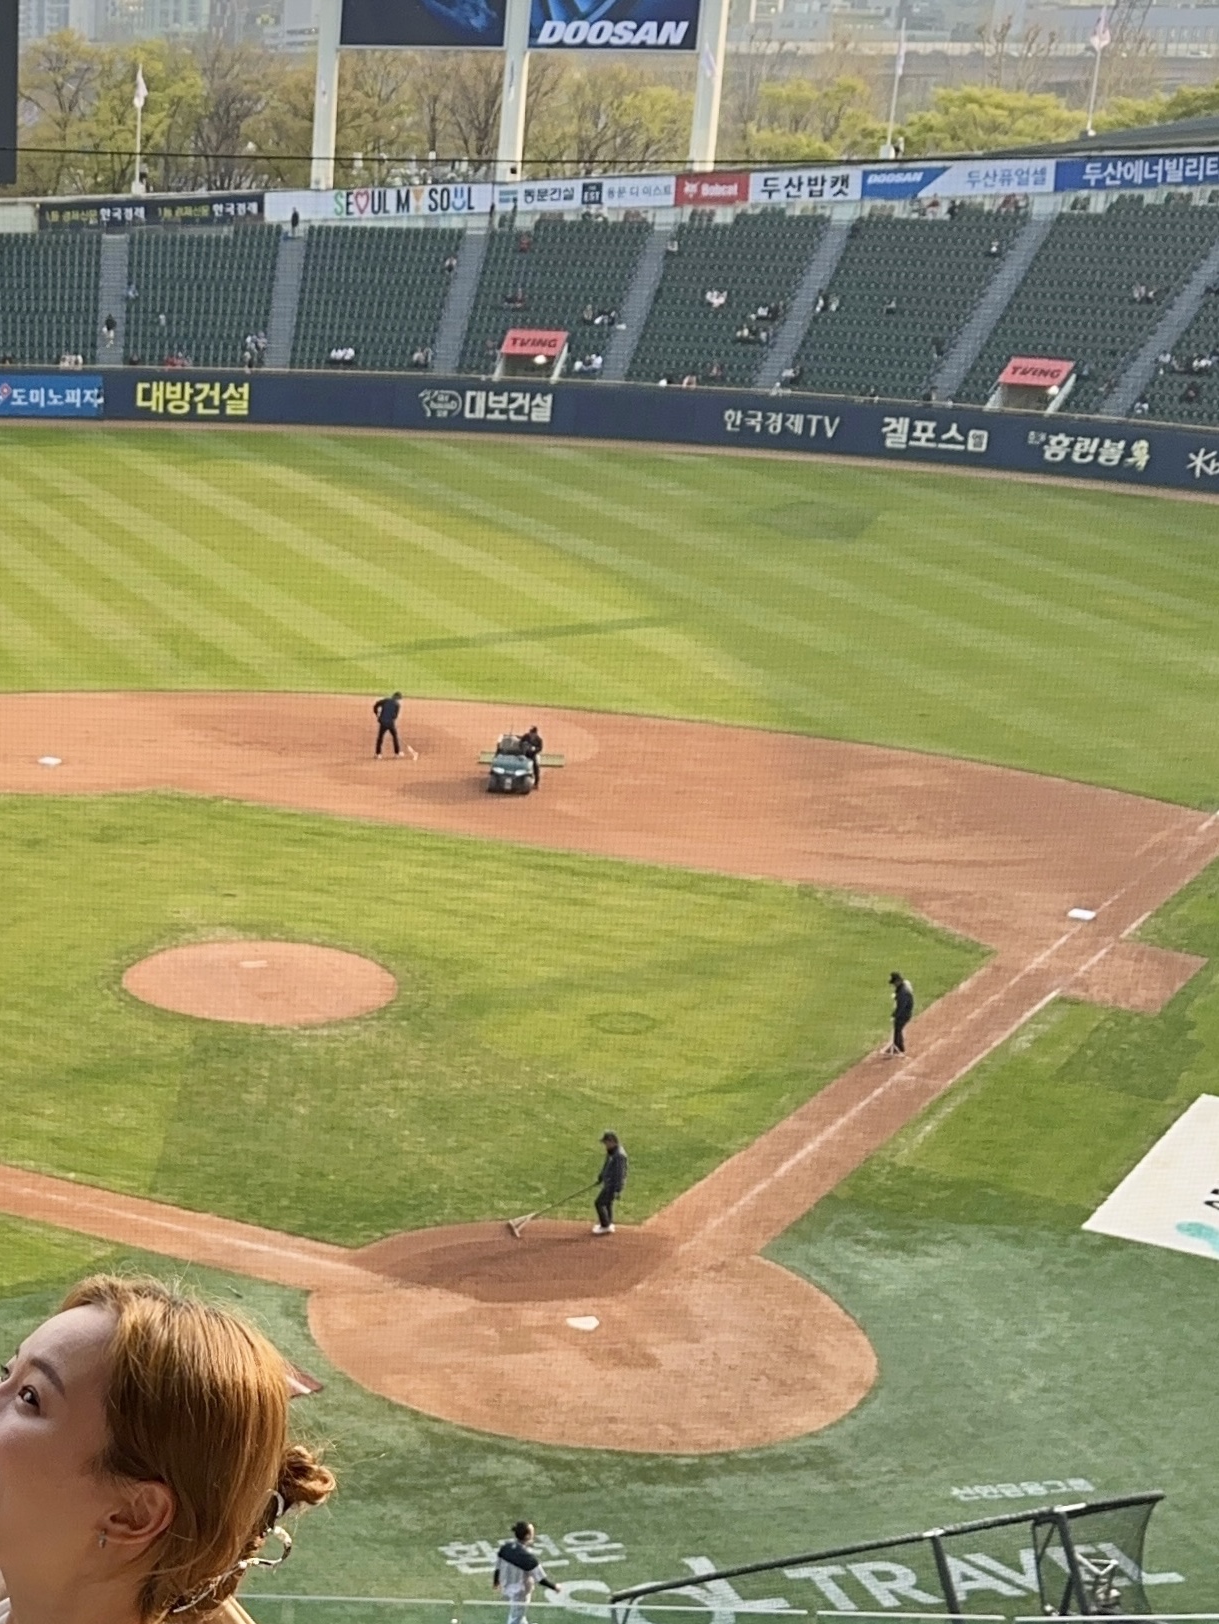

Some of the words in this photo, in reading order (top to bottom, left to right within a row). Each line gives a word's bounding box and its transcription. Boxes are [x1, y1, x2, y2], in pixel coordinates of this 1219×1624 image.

[537, 20, 689, 46] DOOSAN
[760, 174, 851, 200] 두산밥캣
[867, 171, 923, 185] DOOSAN
[966, 166, 1050, 191] 두산퓨얼셀
[428, 186, 475, 212] SOUL
[524, 187, 574, 204] 동문건설
[10, 387, 104, 408] 도미노피자
[136, 381, 250, 416] 대방건설
[464, 390, 553, 422] 대보건설
[723, 408, 841, 440] 한국경제TV
[784, 1542, 1185, 1612] TRAVEL
